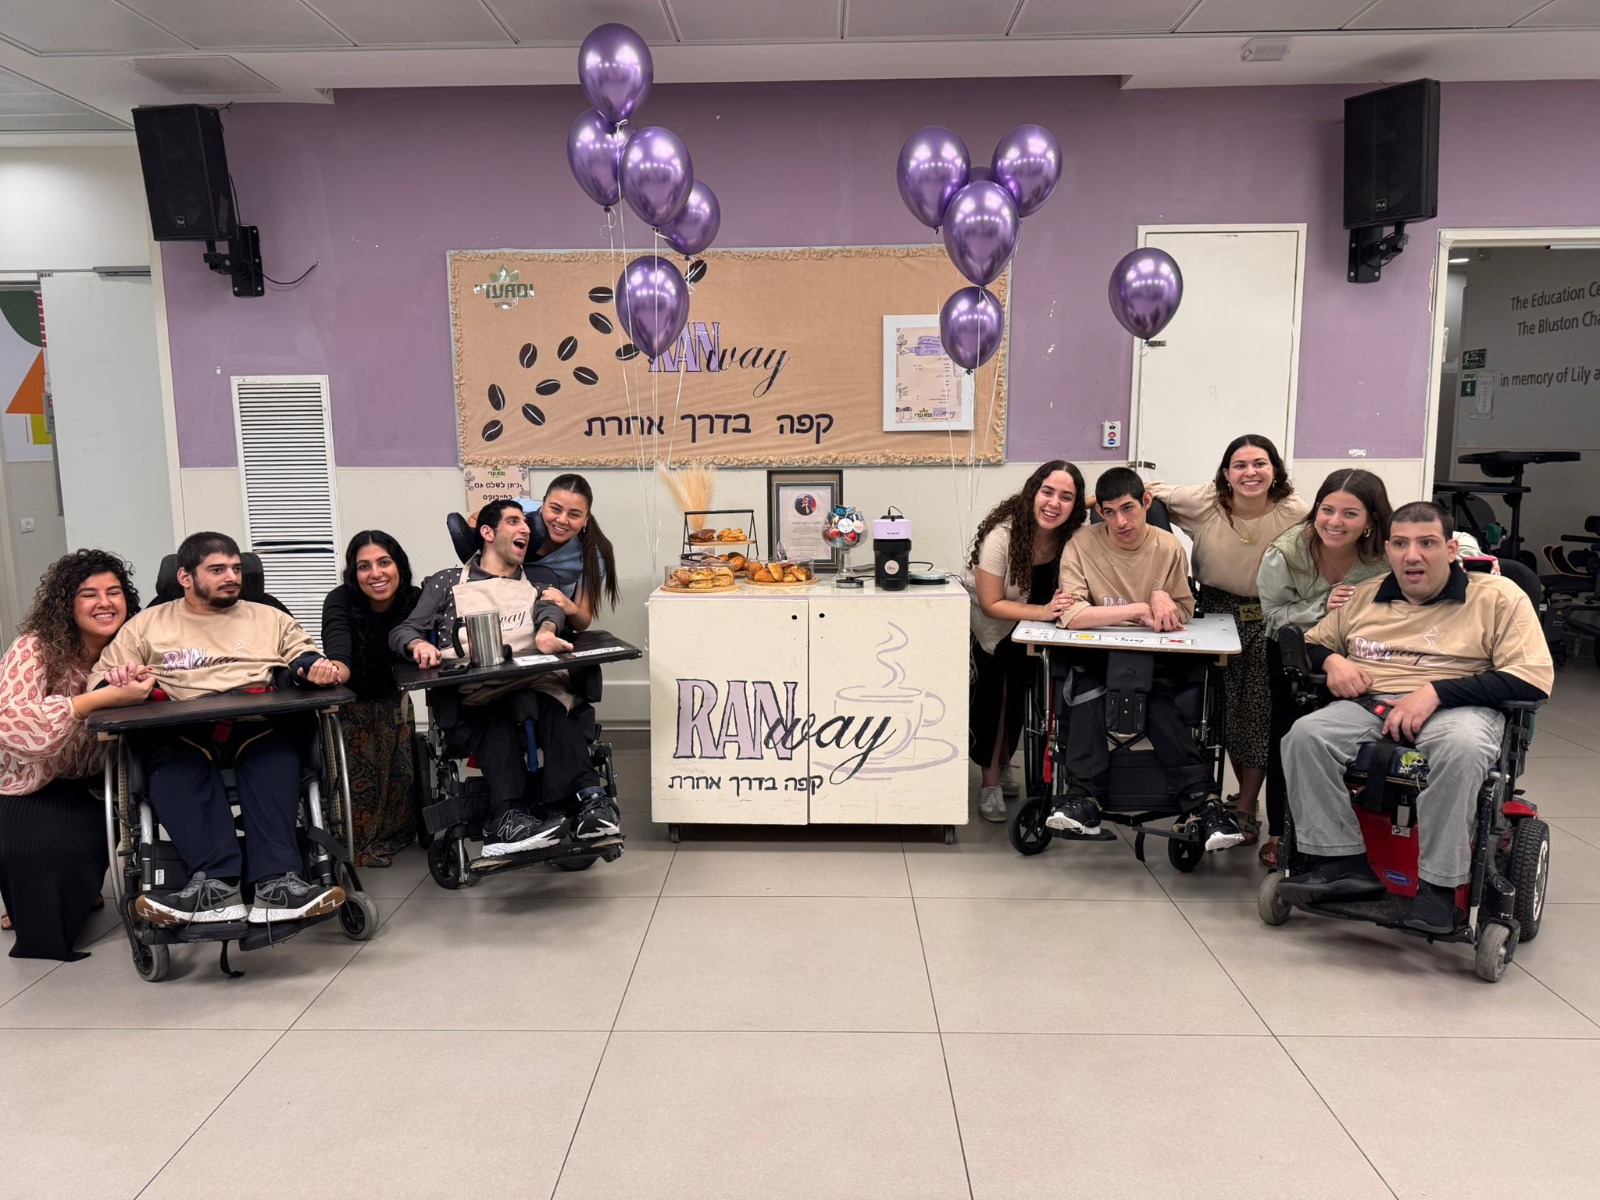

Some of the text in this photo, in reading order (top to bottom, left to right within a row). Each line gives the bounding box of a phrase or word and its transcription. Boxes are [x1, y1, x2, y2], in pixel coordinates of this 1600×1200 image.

[1510, 295, 1529, 311] The
[1531, 286, 1585, 308] Education
[1517, 320, 1536, 336] The
[1538, 317, 1579, 334] Bluston
[1500, 372, 1509, 387] in
[1511, 372, 1554, 388] memory
[1556, 366, 1569, 384] of
[1571, 365, 1591, 386] Lily
[584, 413, 834, 444] קפה בדרך אחרת
[485, 481, 506, 489] לשלם
[507, 482, 520, 490] ניתן
[668, 774, 824, 797] קפה בדרך אחרת
